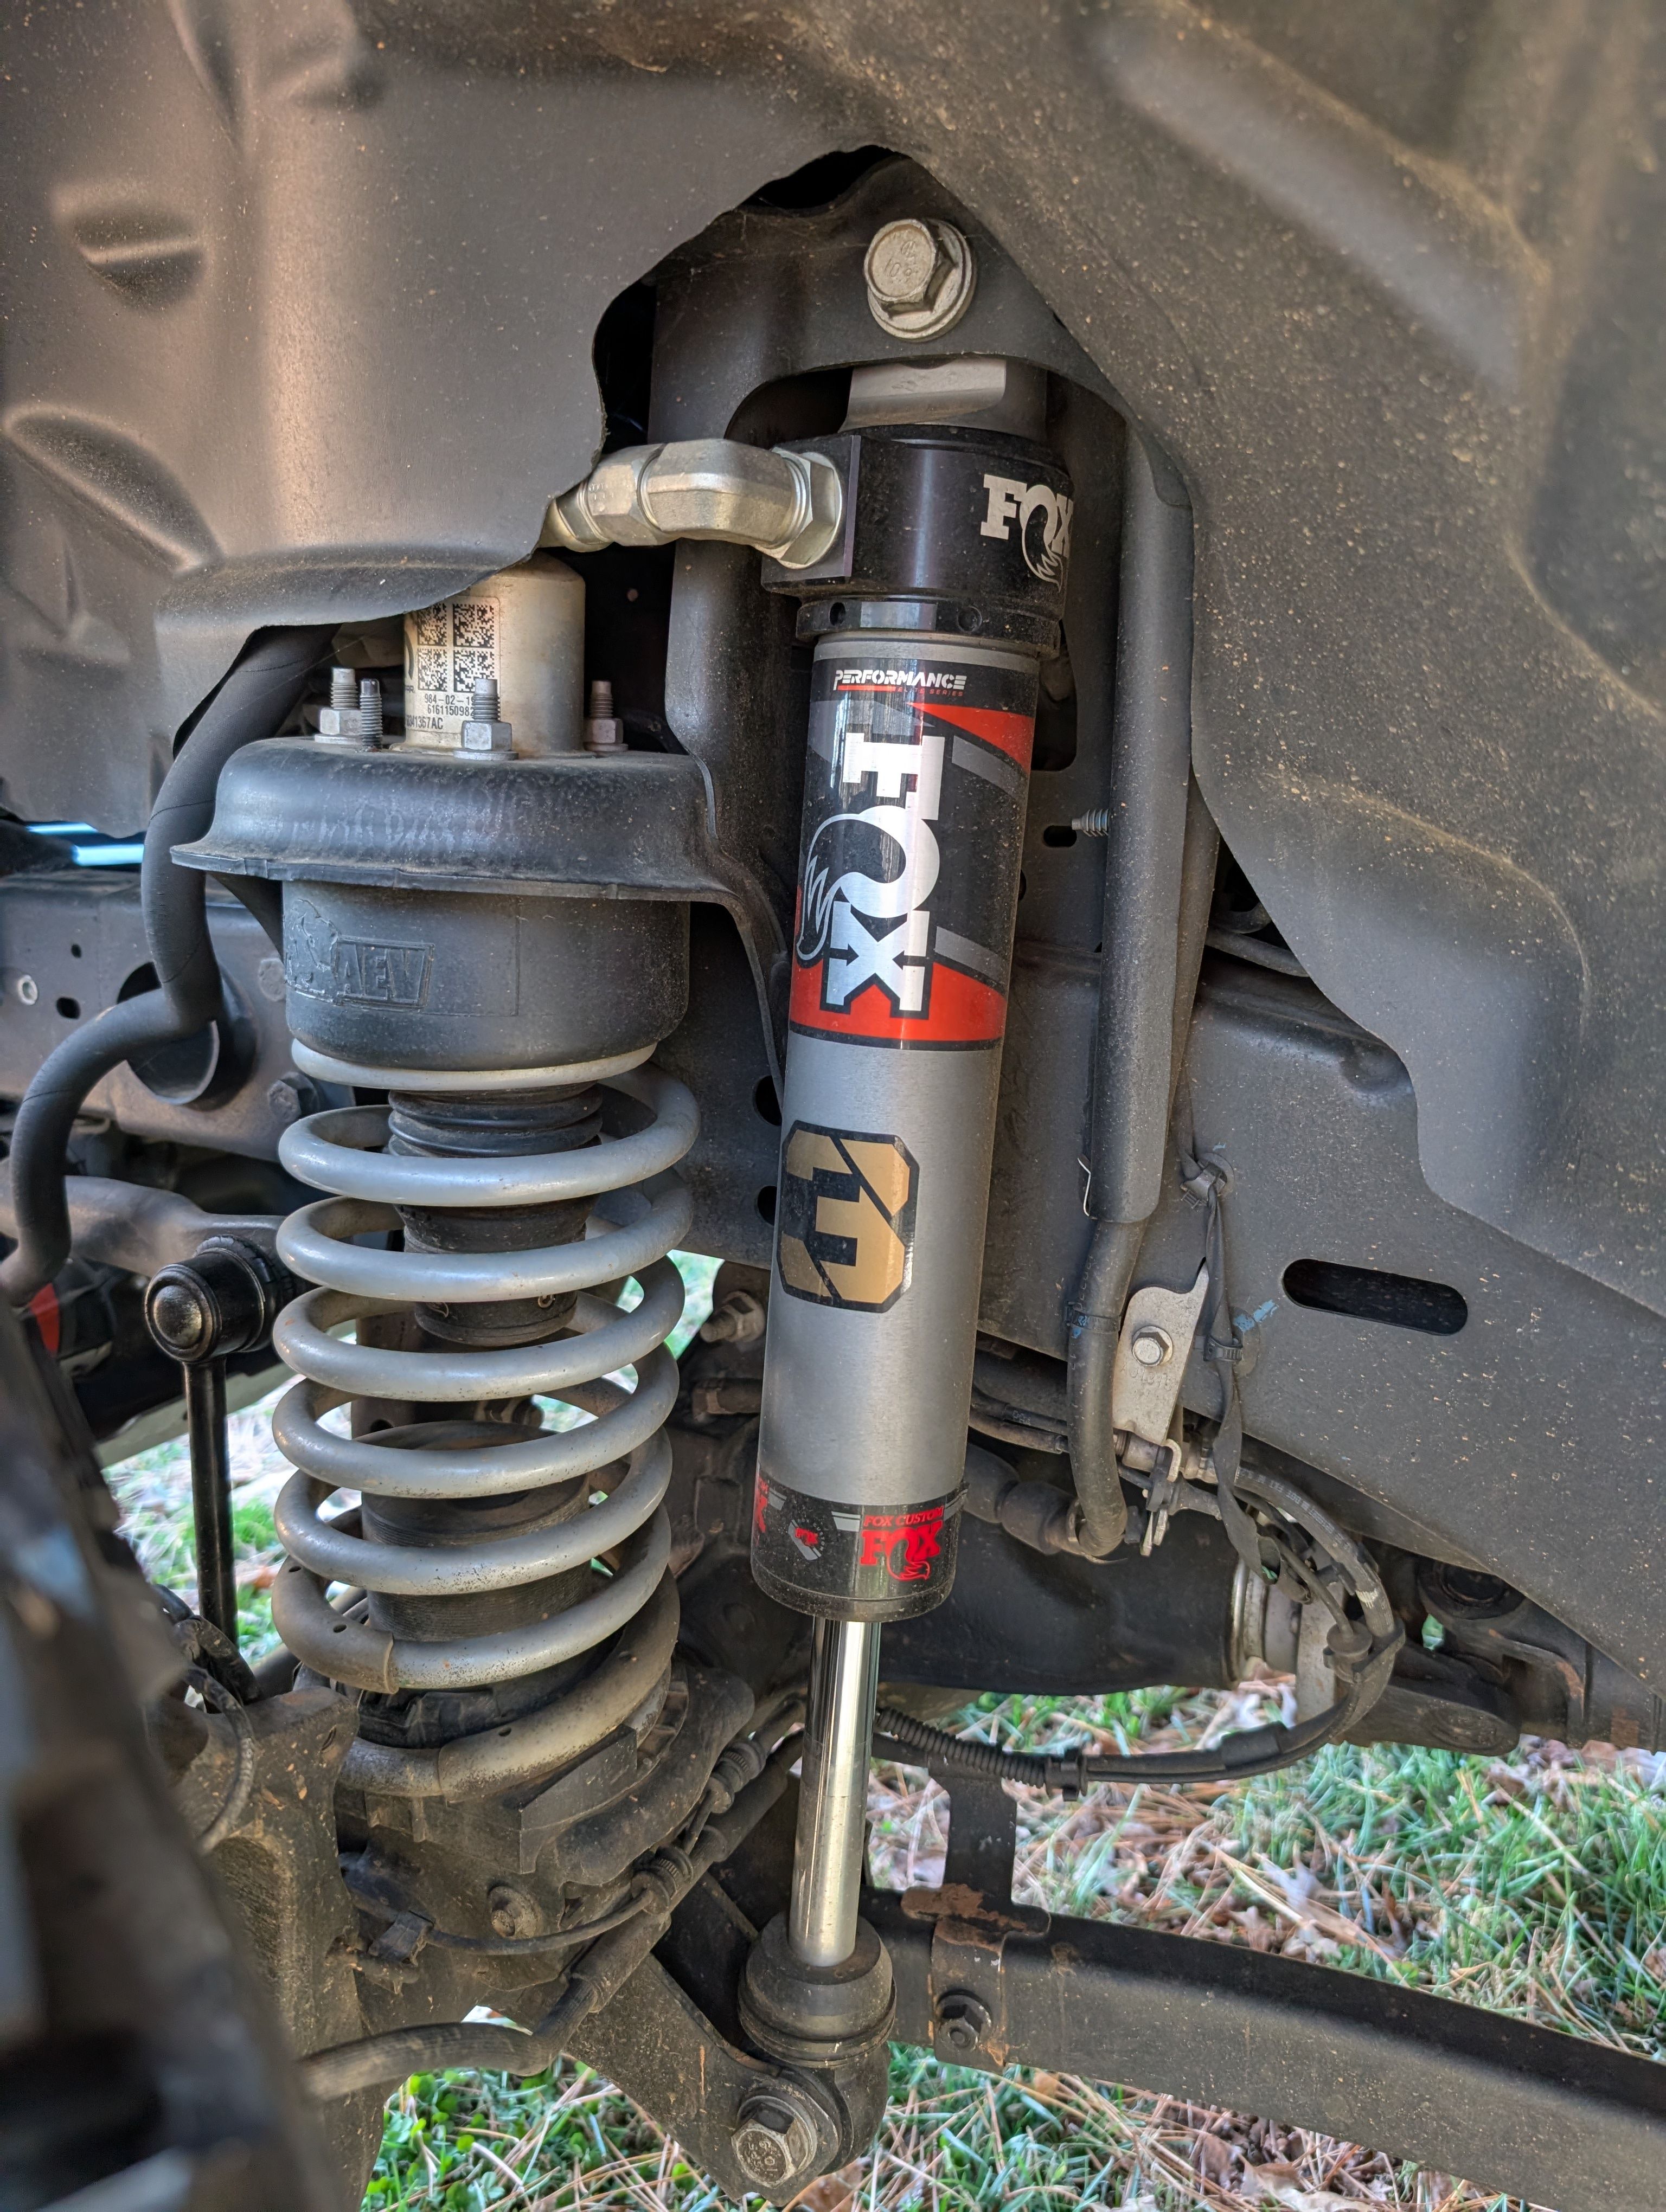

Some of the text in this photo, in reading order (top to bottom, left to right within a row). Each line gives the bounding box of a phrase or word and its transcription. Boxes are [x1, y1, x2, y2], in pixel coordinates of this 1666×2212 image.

[981, 474, 1073, 593] FOX
[833, 670, 967, 691] PERFORMANCE
[898, 686, 925, 695] ELTE
[796, 732, 945, 1011] FOX
[334, 942, 427, 1002] AEV
[864, 1505, 944, 1527] FOX CUSTOM
[860, 1520, 943, 1581] FOX
